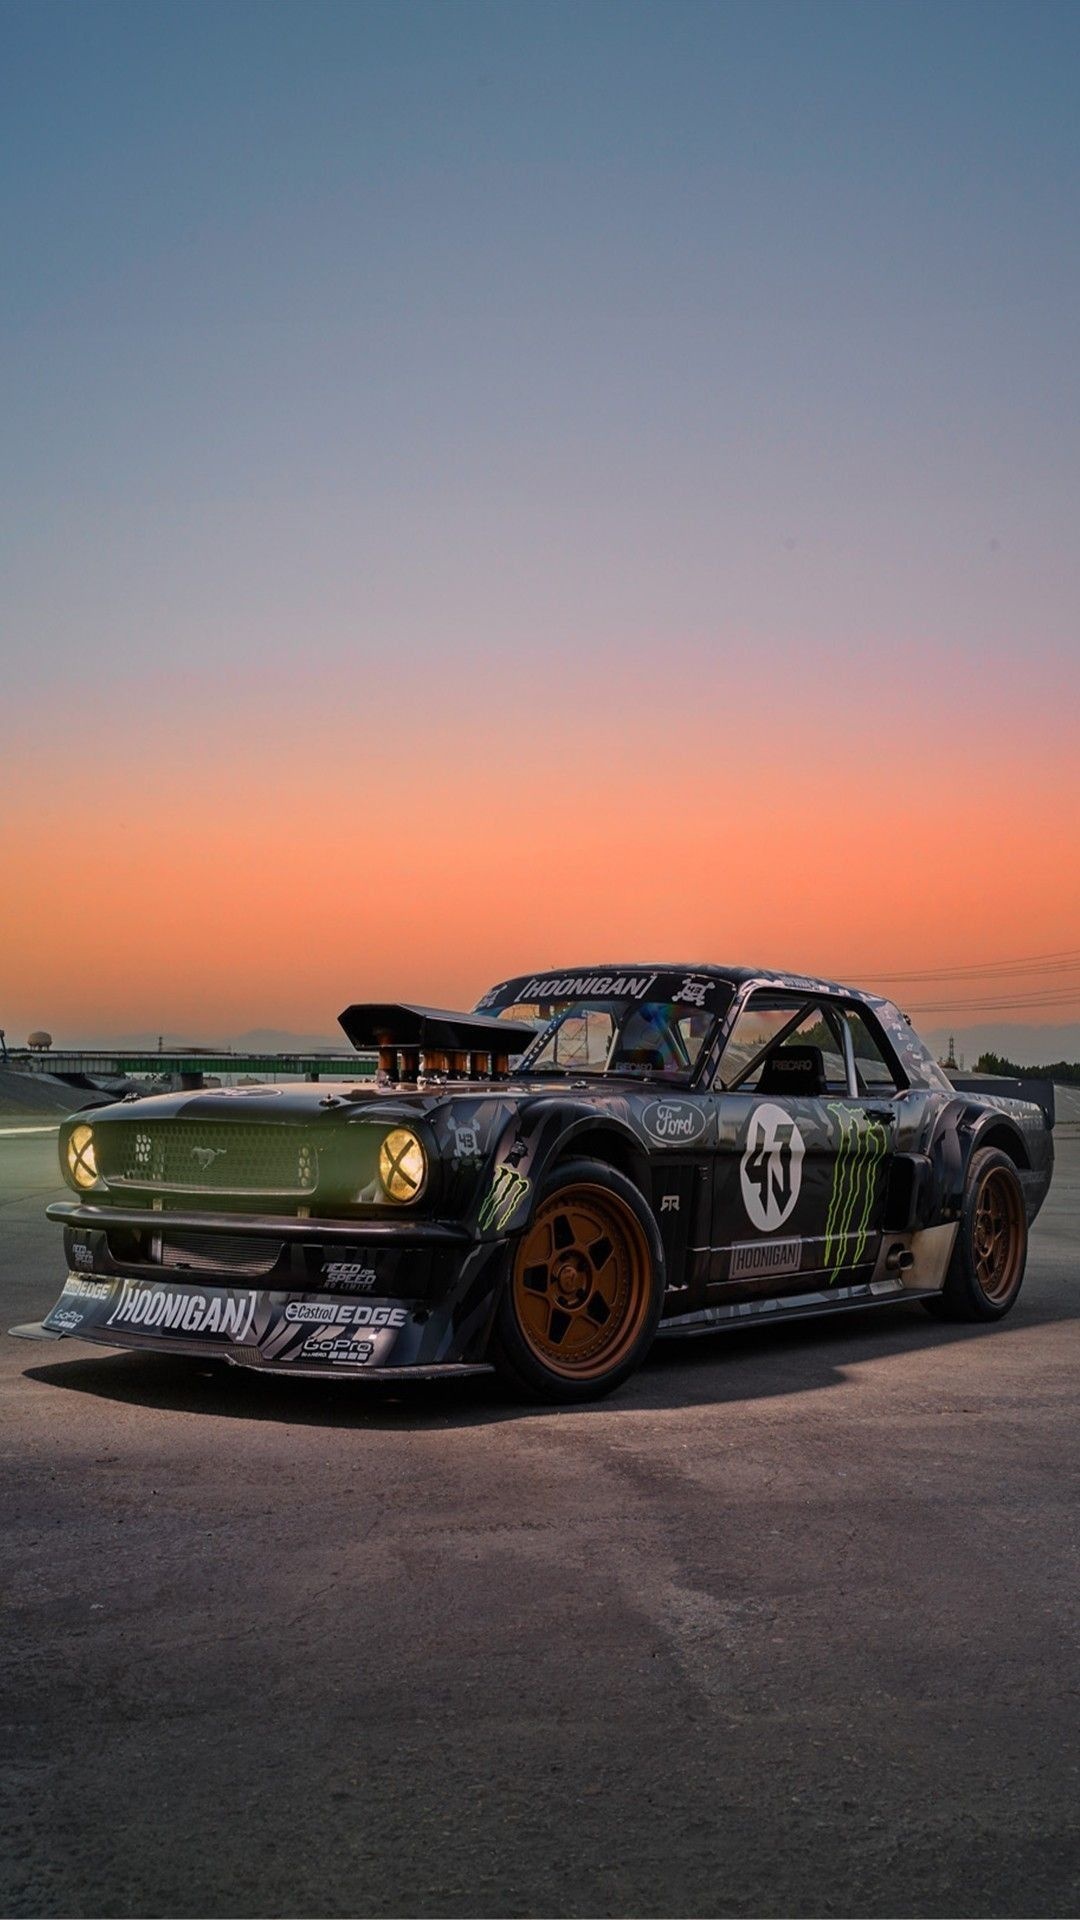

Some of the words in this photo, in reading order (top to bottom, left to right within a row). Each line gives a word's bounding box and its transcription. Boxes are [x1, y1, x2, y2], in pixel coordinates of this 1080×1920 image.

[515, 976, 655, 1002] [HOONIGAN]
[772, 1060, 812, 1071] RECARO
[655, 1104, 695, 1136] Ford
[458, 1133, 474, 1148] 43
[326, 1273, 377, 1285] SPEED
[79, 1281, 111, 1300] EDGE
[54, 1309, 84, 1324] GoPro
[106, 1278, 258, 1341] [HOONIGAN]
[297, 1304, 334, 1321] Castrol
[335, 1305, 409, 1328] EDGE
[303, 1339, 373, 1353] GoPro
